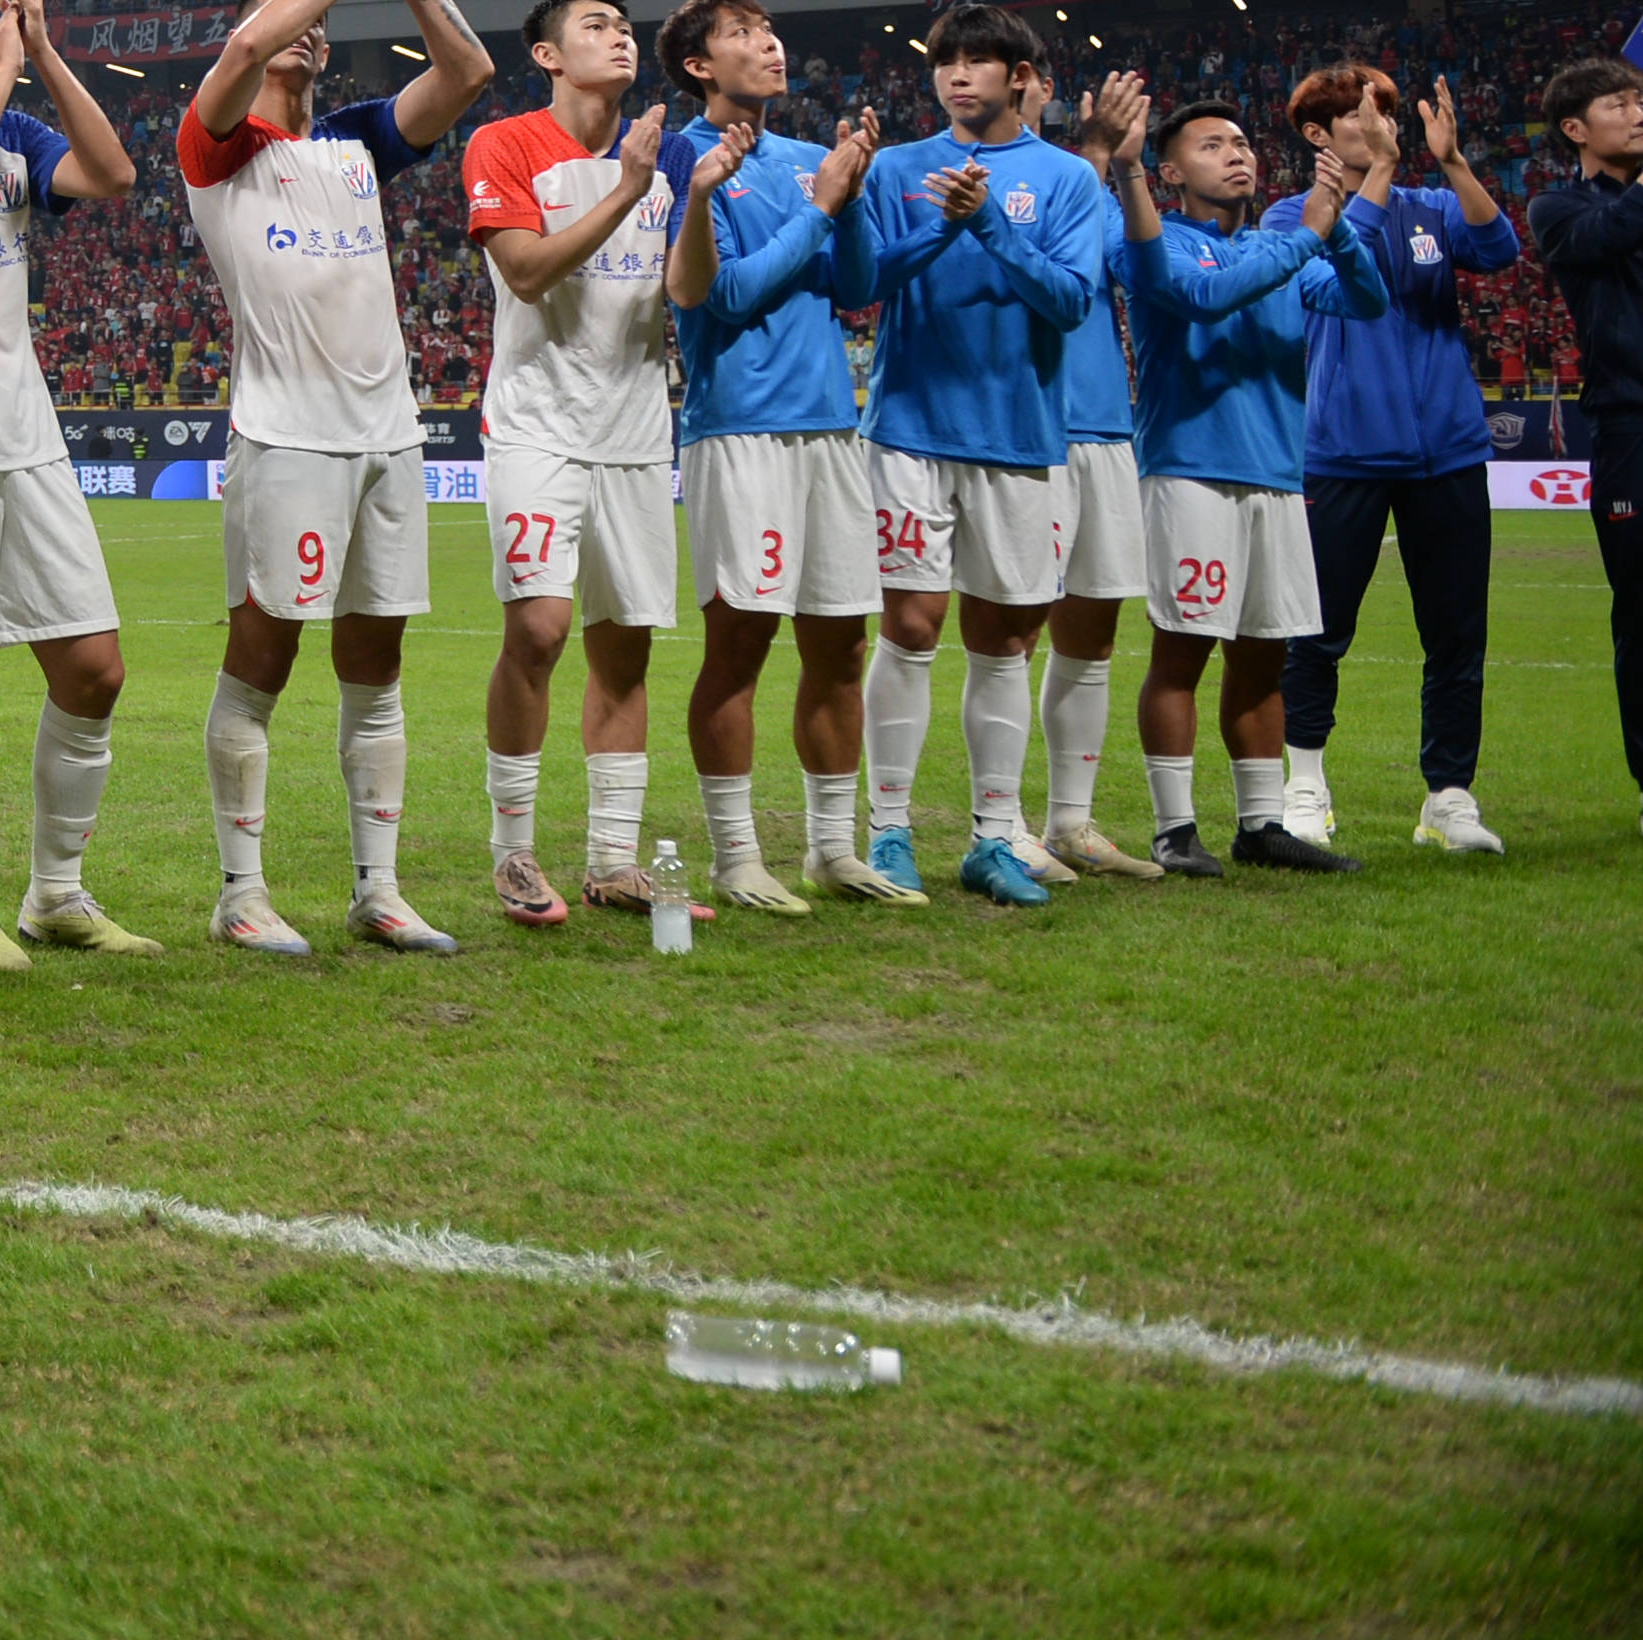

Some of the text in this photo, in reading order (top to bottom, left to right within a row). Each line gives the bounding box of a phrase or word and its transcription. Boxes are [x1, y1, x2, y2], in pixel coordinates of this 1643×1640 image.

[73, 465, 137, 495] 联赛
[298, 531, 325, 587] 9
[506, 512, 557, 564] 27
[762, 529, 784, 579] 3
[876, 509, 927, 559] 34
[1176, 557, 1226, 605] 29
